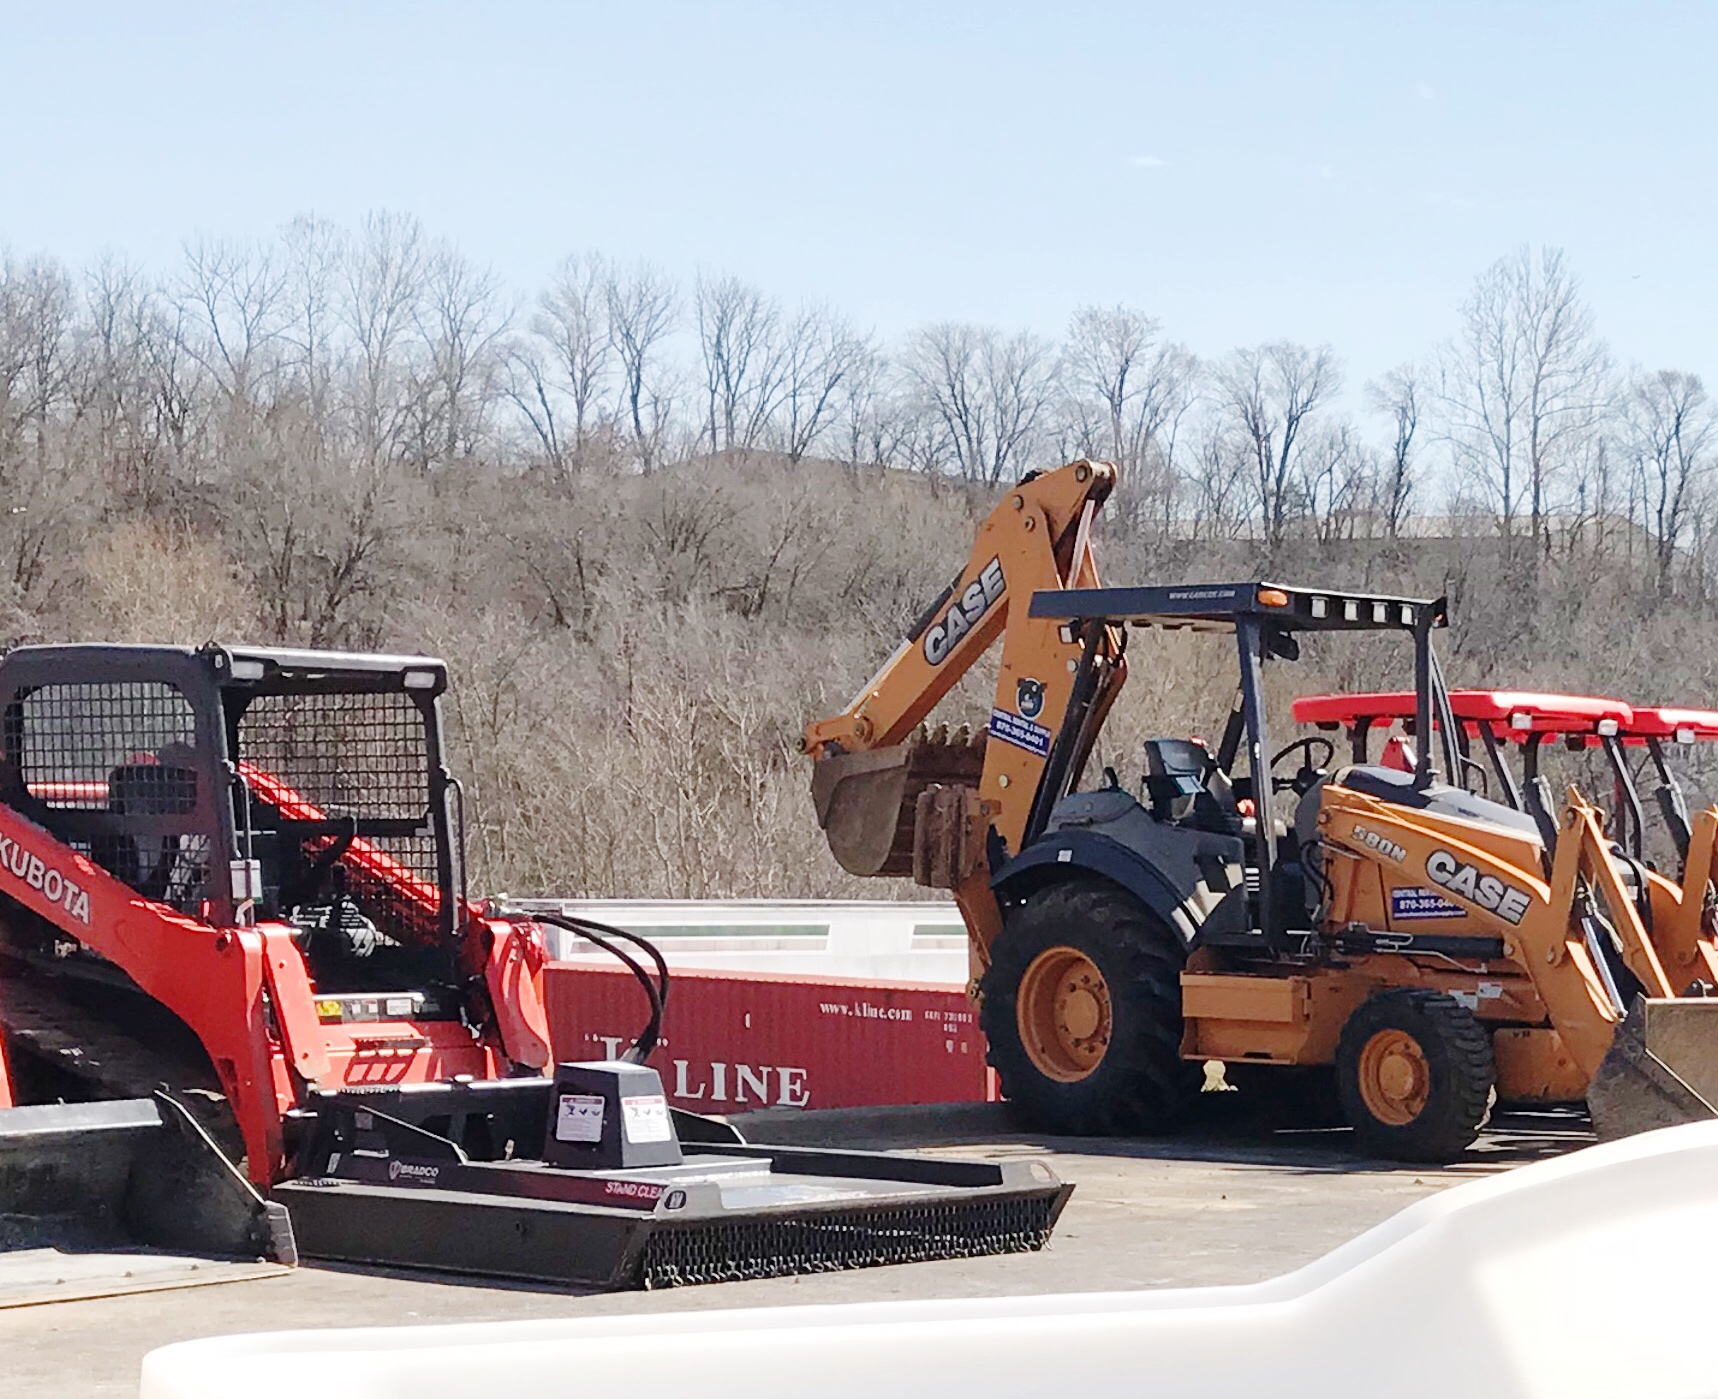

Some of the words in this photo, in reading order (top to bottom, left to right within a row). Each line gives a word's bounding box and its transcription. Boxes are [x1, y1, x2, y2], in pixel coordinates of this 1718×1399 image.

[924, 556, 1006, 664] CASE
[0, 832, 90, 924] KUBOTA
[1352, 824, 1407, 862] 580N
[1427, 849, 1531, 925] CASE
[673, 1059, 811, 1107] LINE
